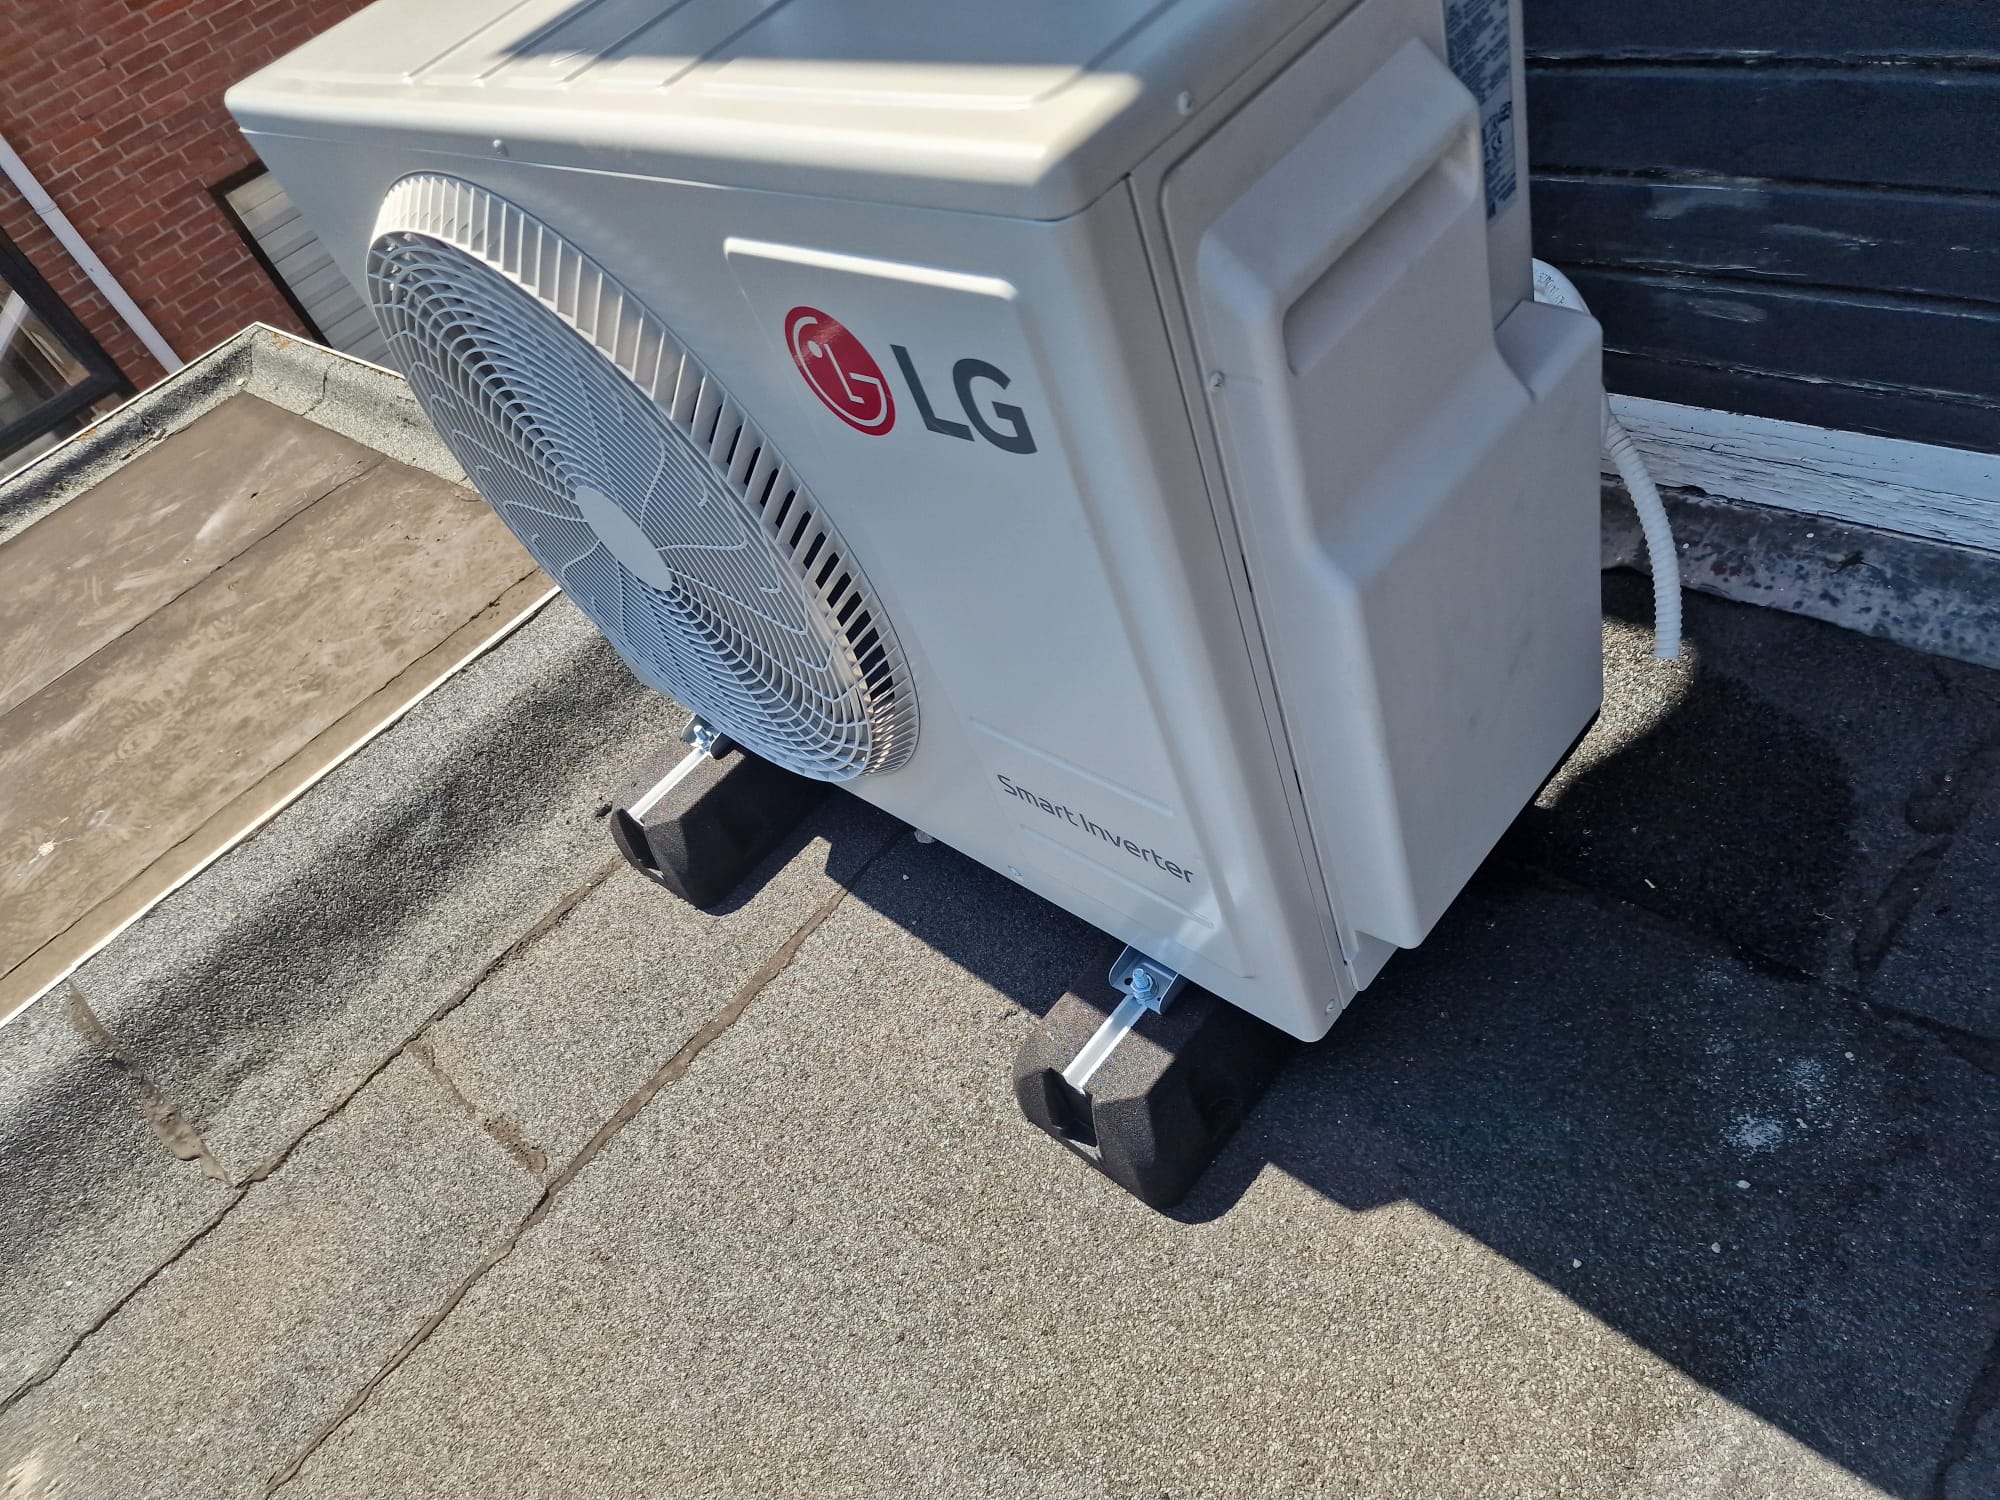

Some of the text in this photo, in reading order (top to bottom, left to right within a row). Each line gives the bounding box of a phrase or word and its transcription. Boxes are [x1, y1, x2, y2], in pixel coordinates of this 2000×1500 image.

[889, 343, 1039, 455] LG
[997, 773, 1195, 883] Smart Inverter
